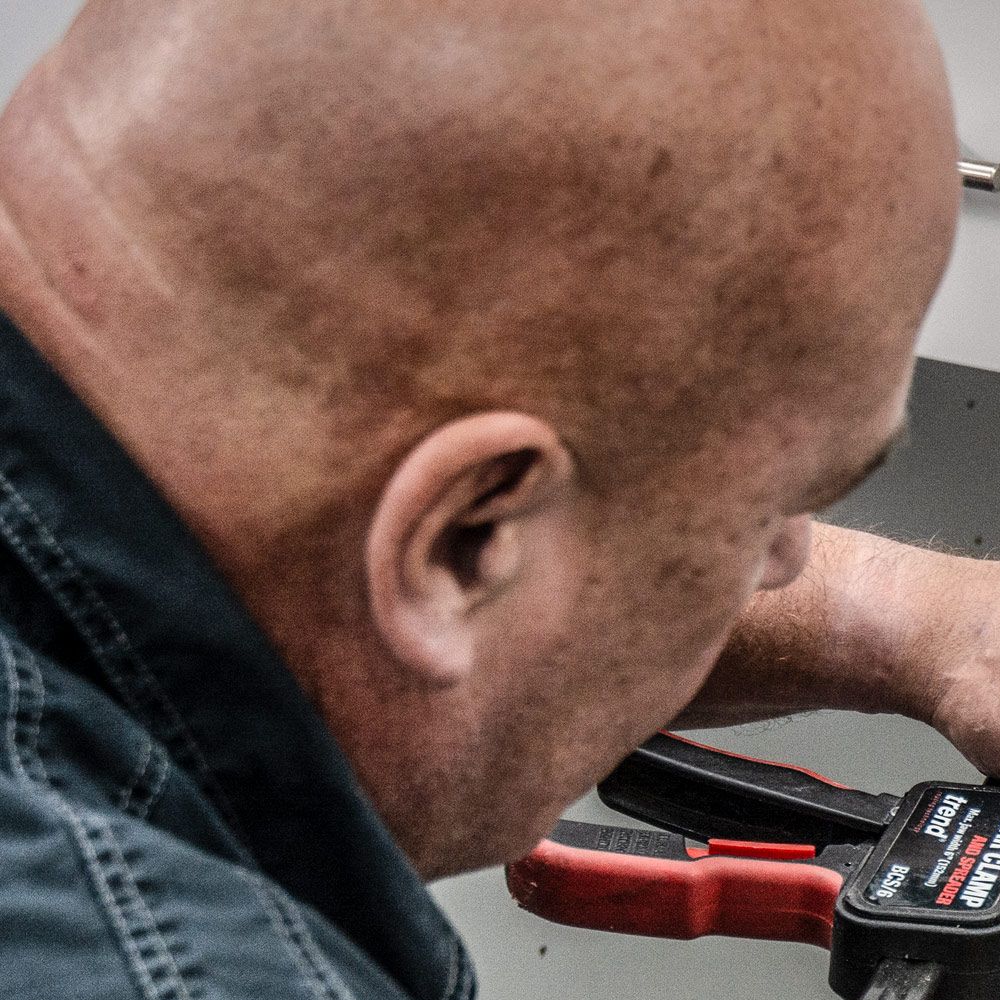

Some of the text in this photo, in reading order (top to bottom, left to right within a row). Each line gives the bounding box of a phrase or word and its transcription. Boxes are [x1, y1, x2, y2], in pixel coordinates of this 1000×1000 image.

[924, 794, 967, 839] trend
[876, 863, 910, 898] BCS/6
[924, 859, 950, 887] (152mm)
[935, 834, 988, 906] AND SPREADER
